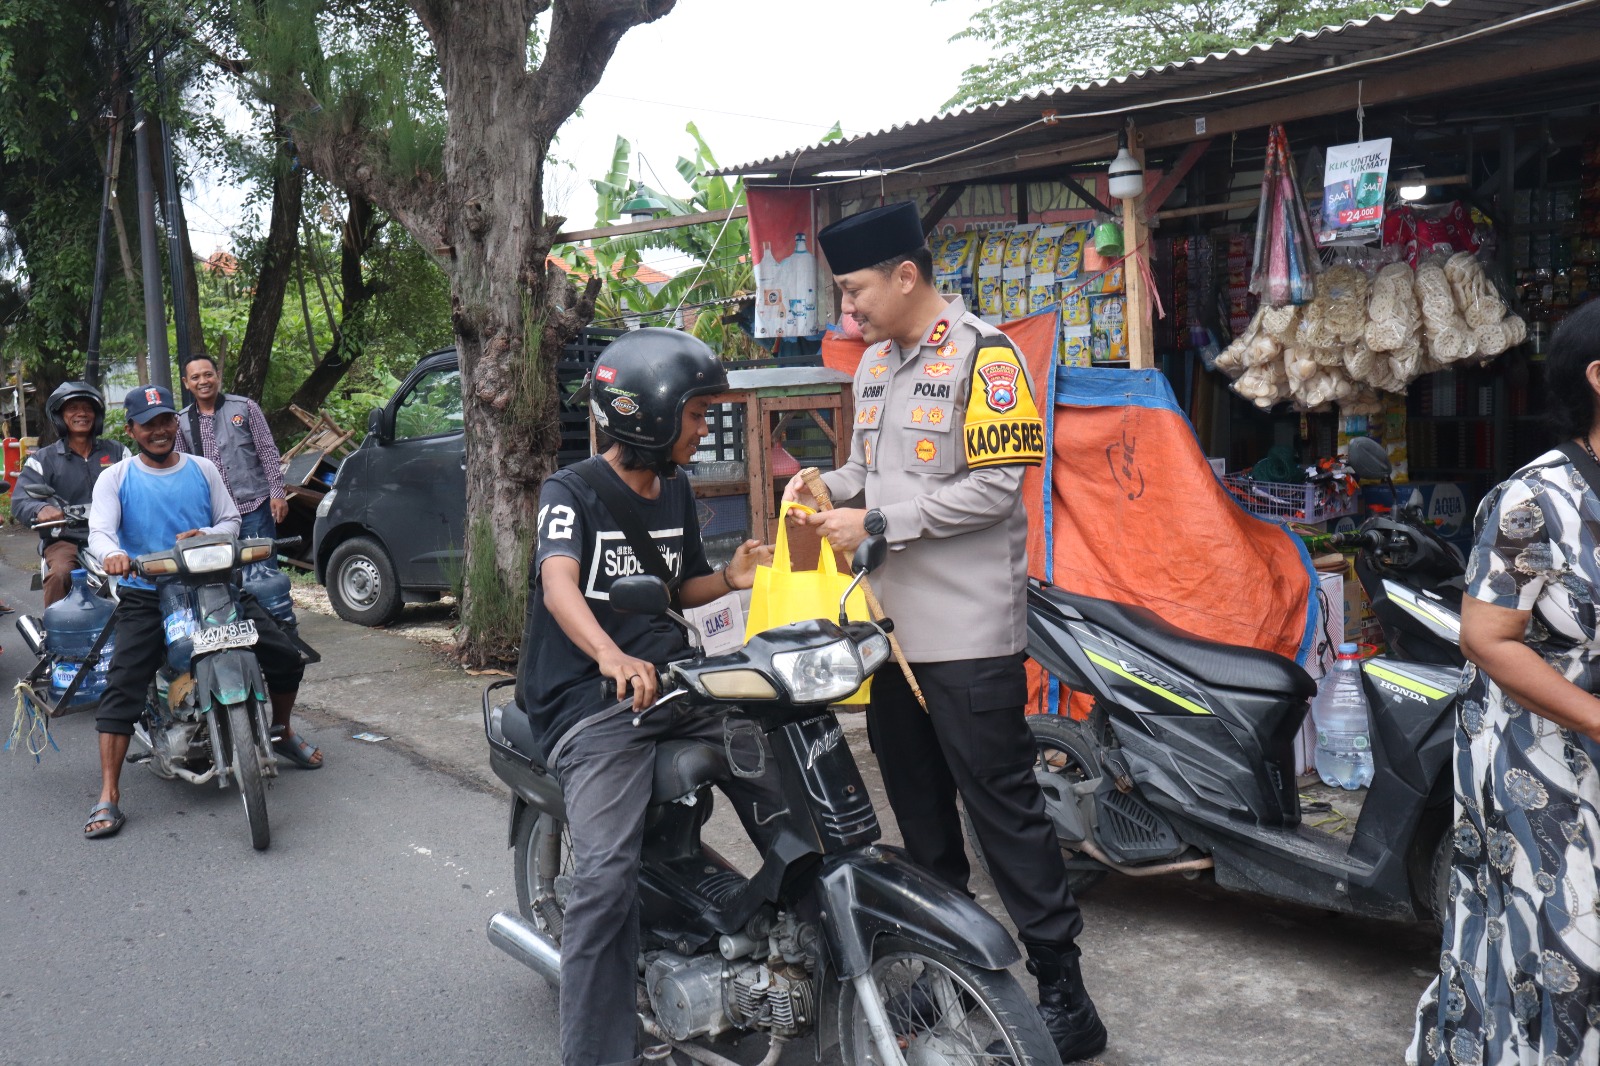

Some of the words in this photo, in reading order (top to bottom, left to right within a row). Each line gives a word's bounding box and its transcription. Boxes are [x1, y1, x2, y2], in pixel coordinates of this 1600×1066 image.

[1328, 160, 1349, 171] KLIK
[1350, 152, 1382, 167] UNTUK
[1350, 158, 1388, 174] NIKMATI
[1363, 182, 1381, 191] SAAT
[1328, 190, 1350, 204] SAAT
[1346, 208, 1374, 222] 24.000
[862, 384, 885, 398] BOBBY
[914, 383, 950, 398] POLRI
[966, 422, 1043, 458] KAOPSRES
[1434, 496, 1462, 517] AQUA
[705, 614, 725, 634] CLAS
[1380, 680, 1429, 706] HONDA
[801, 714, 830, 727] HONDA
